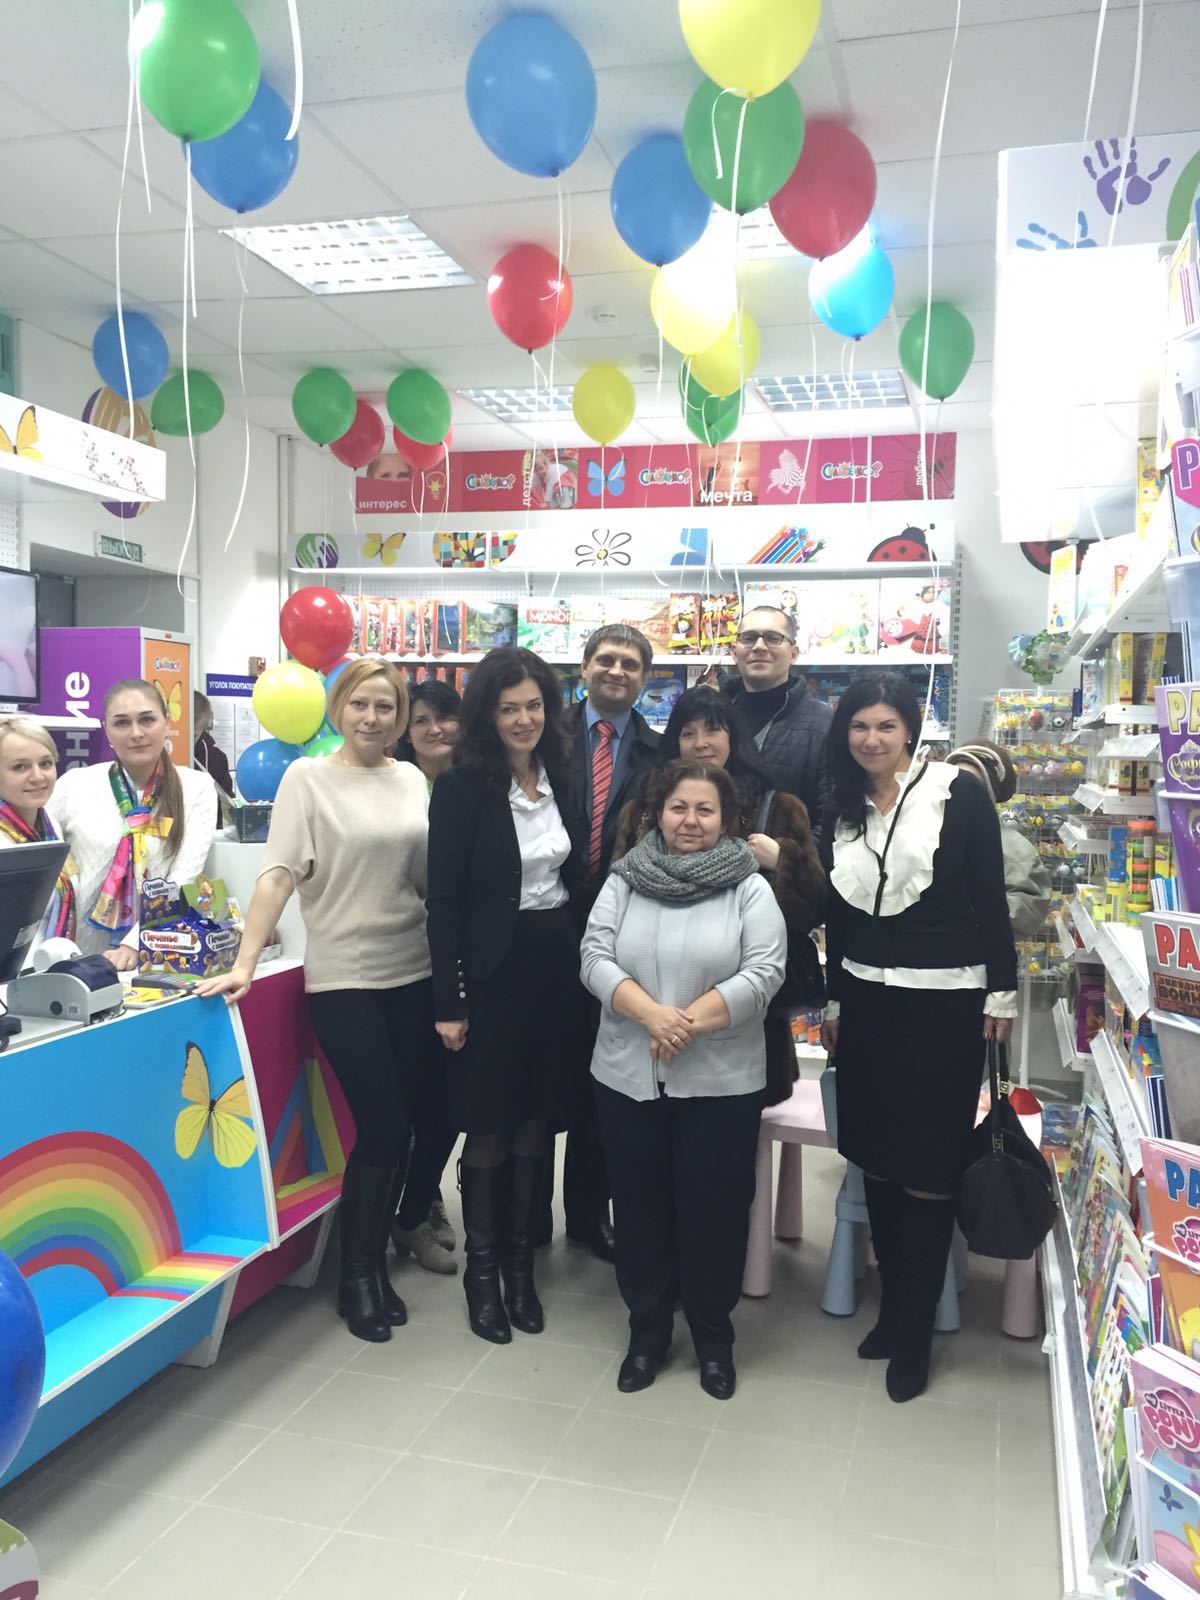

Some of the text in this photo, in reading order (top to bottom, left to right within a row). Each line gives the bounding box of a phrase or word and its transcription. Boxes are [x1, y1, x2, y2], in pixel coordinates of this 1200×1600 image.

[359, 500, 408, 511] интерес
[102, 538, 140, 562] ВЫХОД
[208, 681, 254, 690] УГОЛОК ПОКУПАТЕ
[143, 931, 178, 943] Печенье
[1160, 1401, 1184, 1418] LITTLE
[1143, 1405, 1200, 1448] PONY
